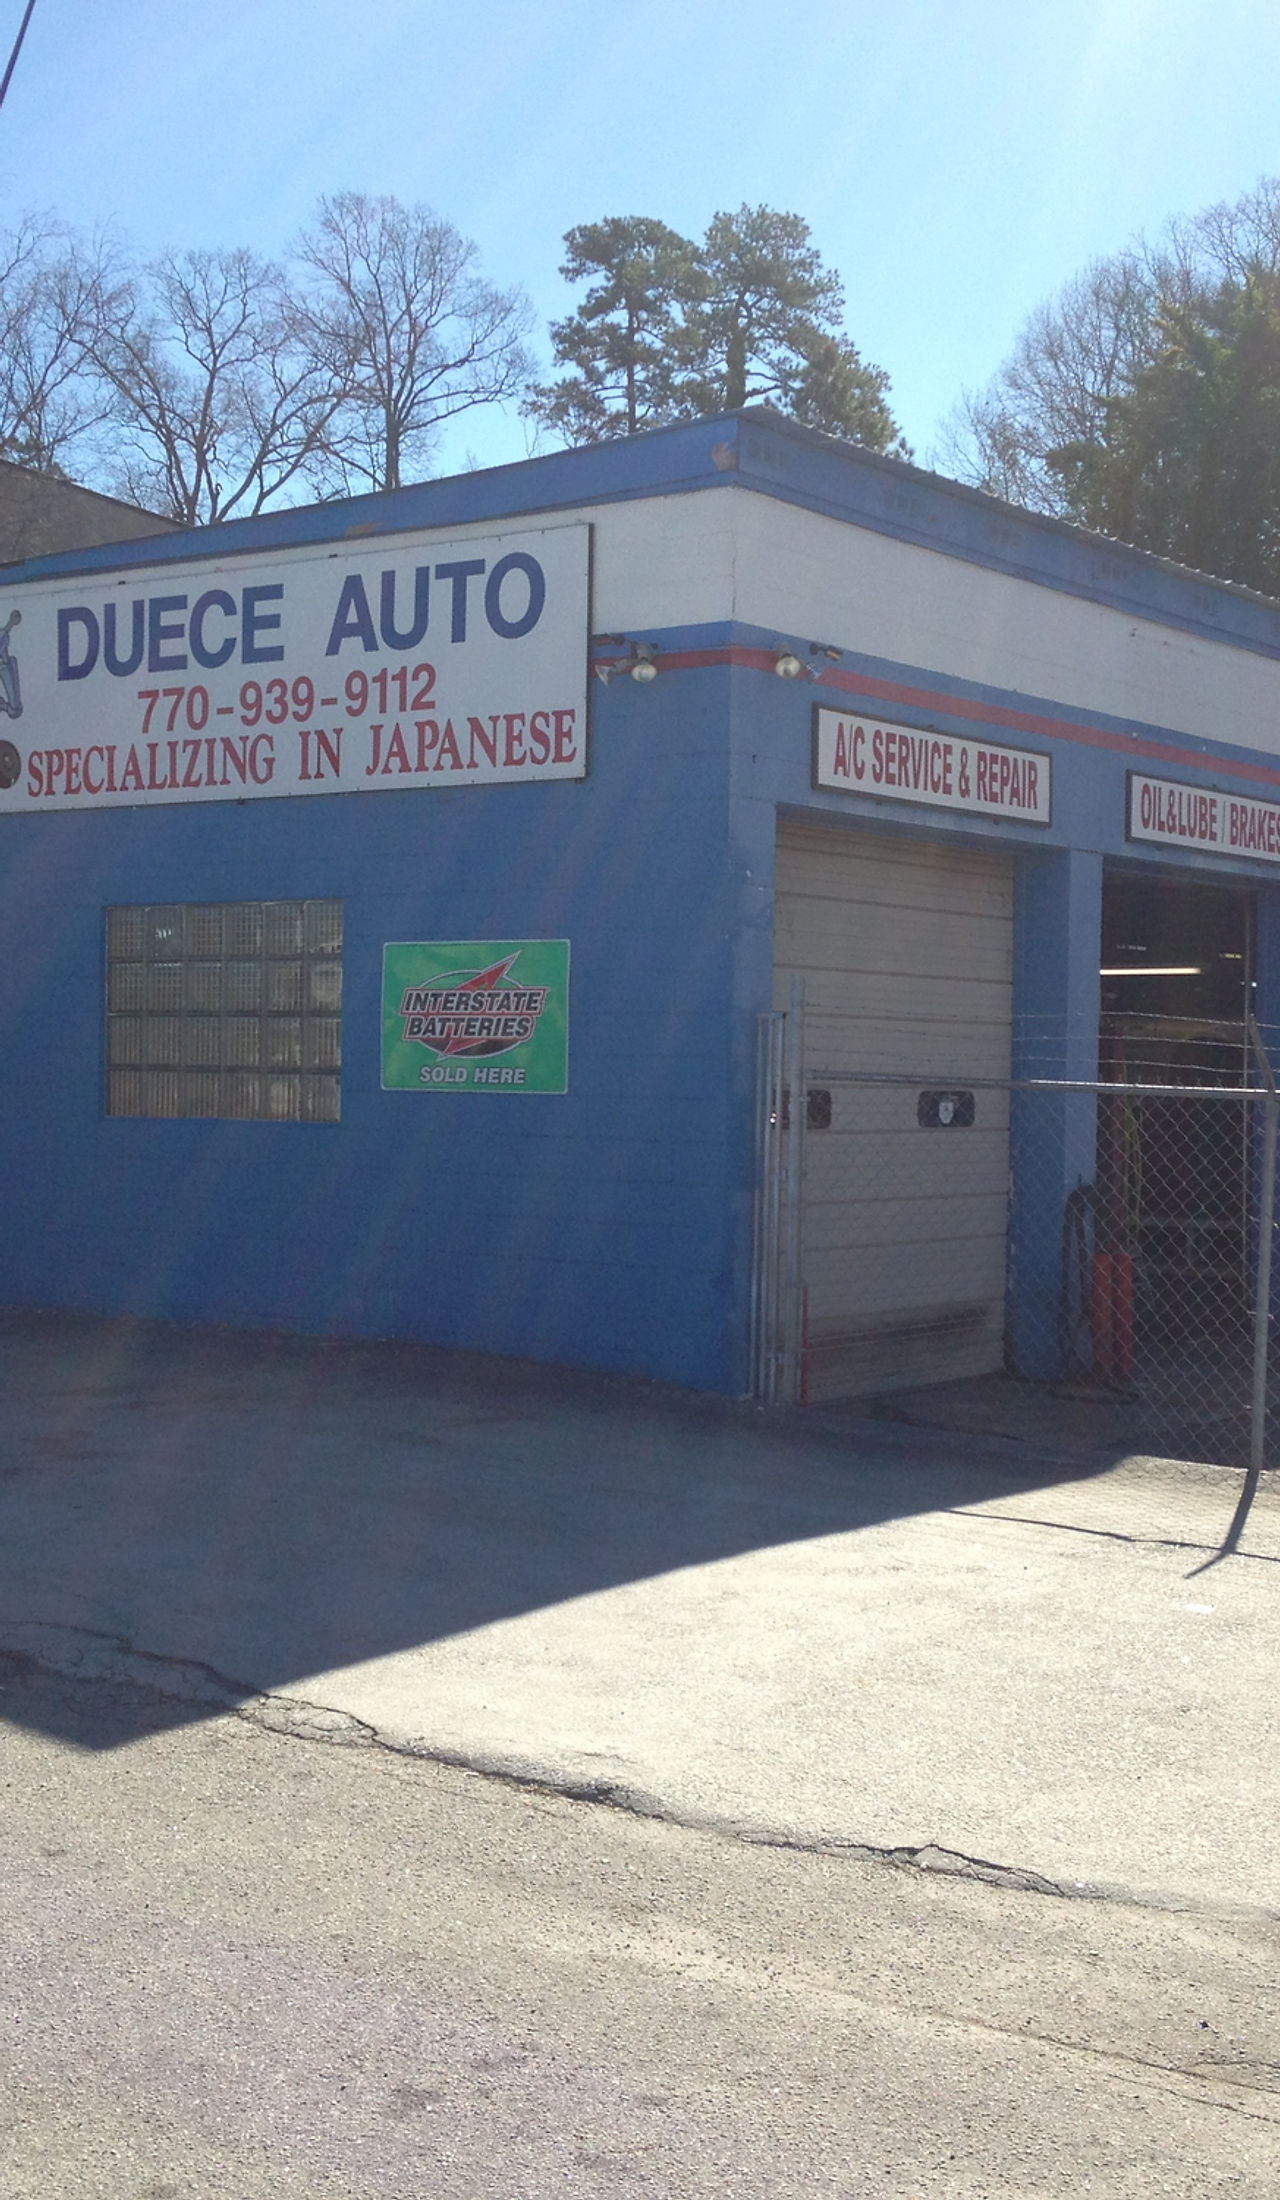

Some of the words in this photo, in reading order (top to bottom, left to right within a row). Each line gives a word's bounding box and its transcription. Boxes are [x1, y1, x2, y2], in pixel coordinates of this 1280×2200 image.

[57, 583, 285, 682] DUECE
[325, 551, 546, 657] AUTO
[137, 663, 437, 734] 770-939-9112
[27, 733, 275, 798] SPECIALIZING
[298, 727, 344, 781] IN
[365, 708, 578, 776] JAPANESE
[833, 722, 865, 781] A/C
[872, 729, 953, 796] SERVICE
[959, 747, 970, 798] &
[977, 751, 1038, 809] REPAIR
[1141, 783, 1217, 842] OIL&LUBE
[405, 992, 540, 1012] INTERSTATE
[408, 1017, 530, 1037] BATTERIES
[419, 1067, 466, 1083] SOLD
[474, 1068, 526, 1084] HERE
